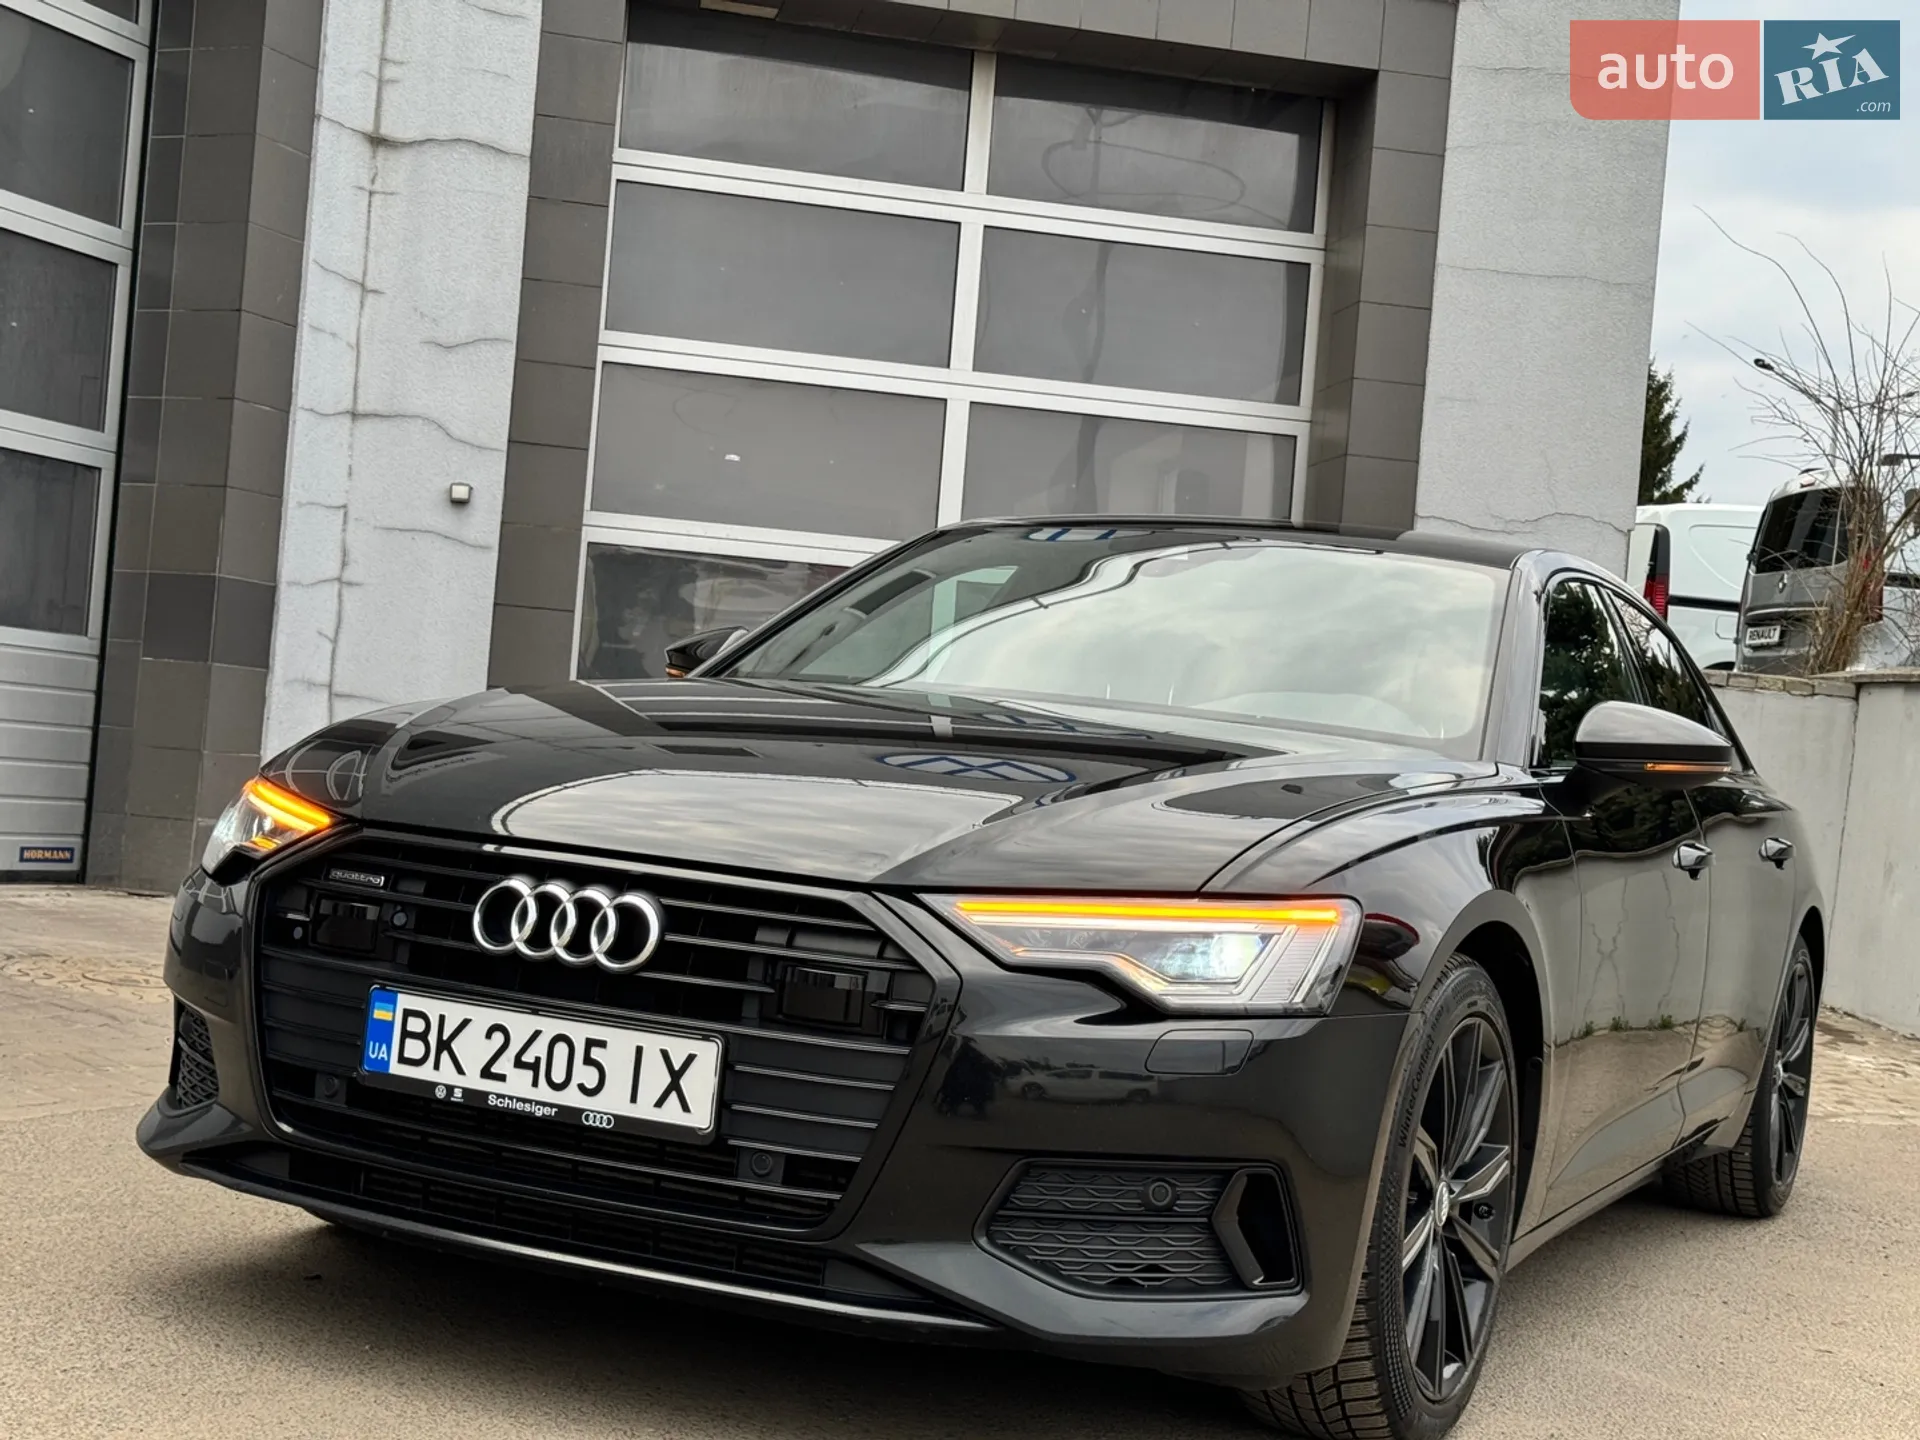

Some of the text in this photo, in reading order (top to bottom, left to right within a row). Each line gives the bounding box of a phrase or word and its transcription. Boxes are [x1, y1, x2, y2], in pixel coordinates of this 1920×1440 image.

[330, 869, 381, 885] quattro
[368, 1040, 388, 1061] UA
[397, 1008, 698, 1113] BK 2405 IX
[1398, 1034, 1435, 1148] WinterContact
[488, 1094, 558, 1117] Schlesiger
